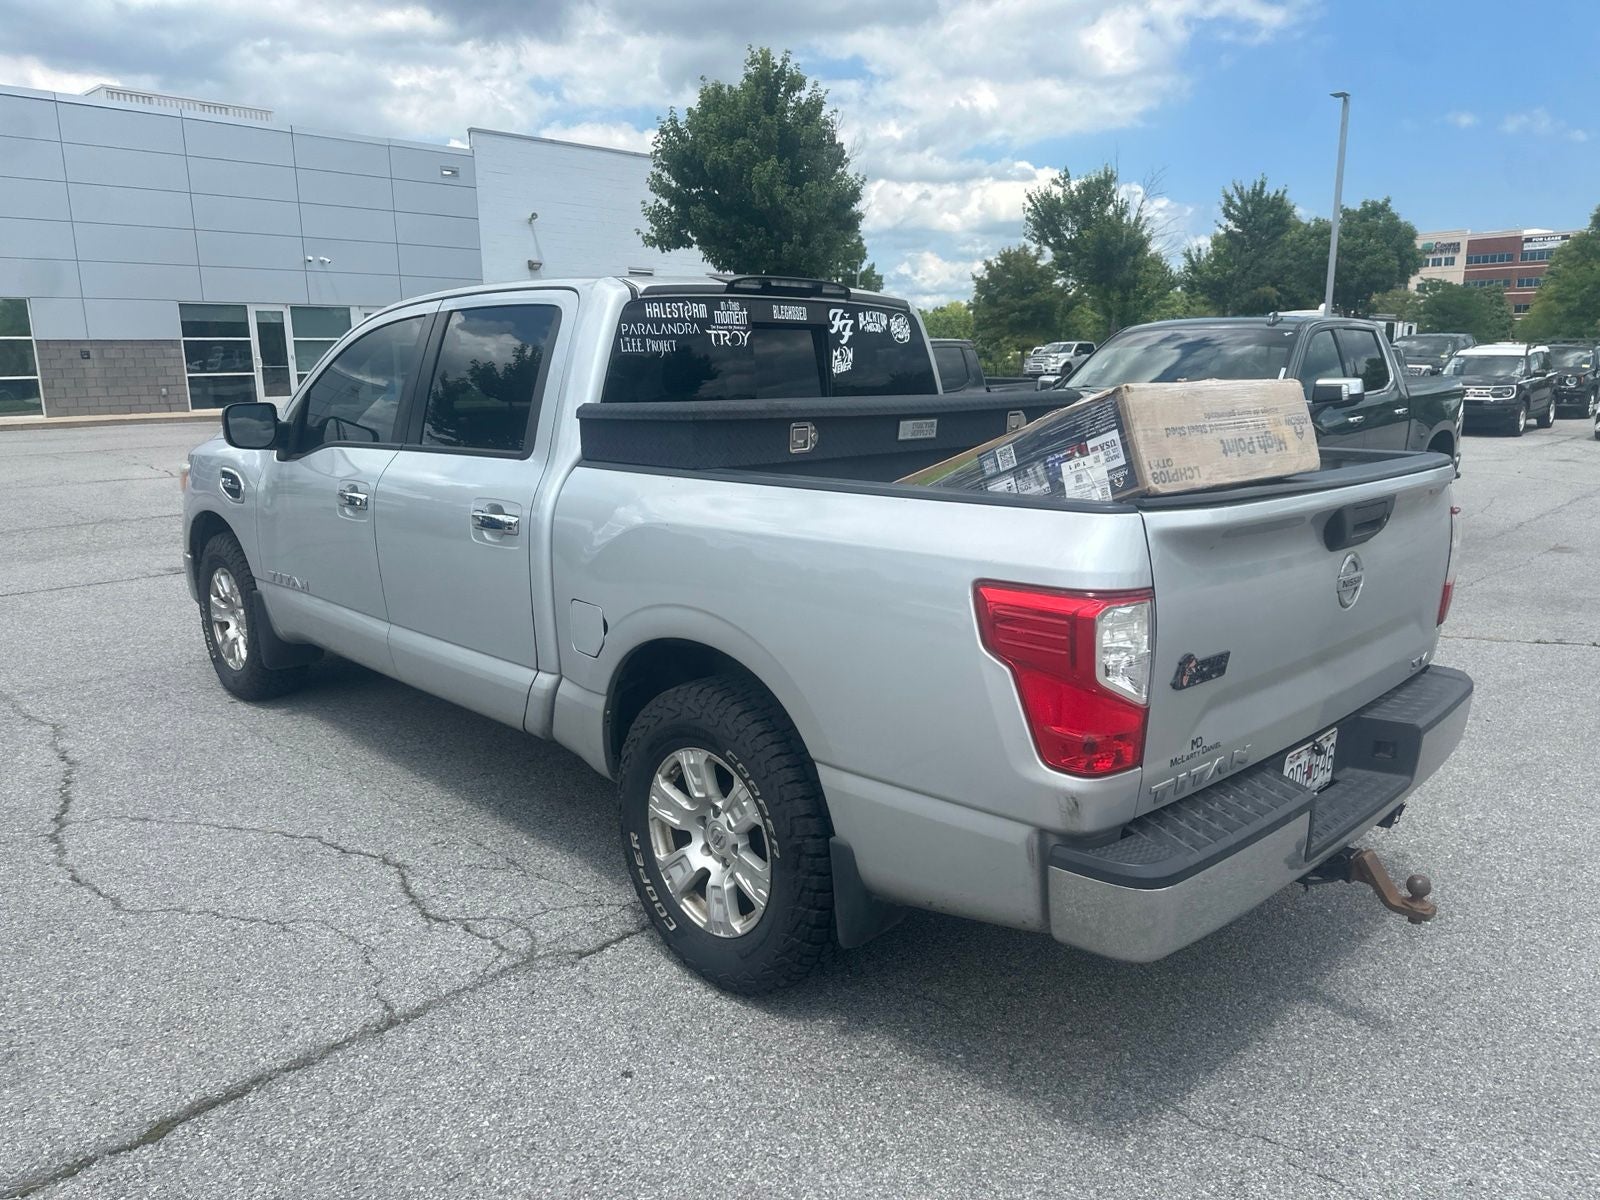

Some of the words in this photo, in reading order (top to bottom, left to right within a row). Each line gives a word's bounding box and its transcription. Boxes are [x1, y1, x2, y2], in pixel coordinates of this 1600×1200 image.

[645, 301, 707, 320] HALESTORM
[620, 323, 701, 335] PARALANDRA
[646, 338, 677, 358] PROJECT
[1098, 438, 1117, 450] USA
[1220, 436, 1257, 457] Point
[1259, 431, 1288, 454] High
[1152, 465, 1201, 485] LCHP108
[1149, 743, 1252, 804] TITAN
[726, 749, 780, 859] COOPER
[630, 831, 677, 932] COOPER
